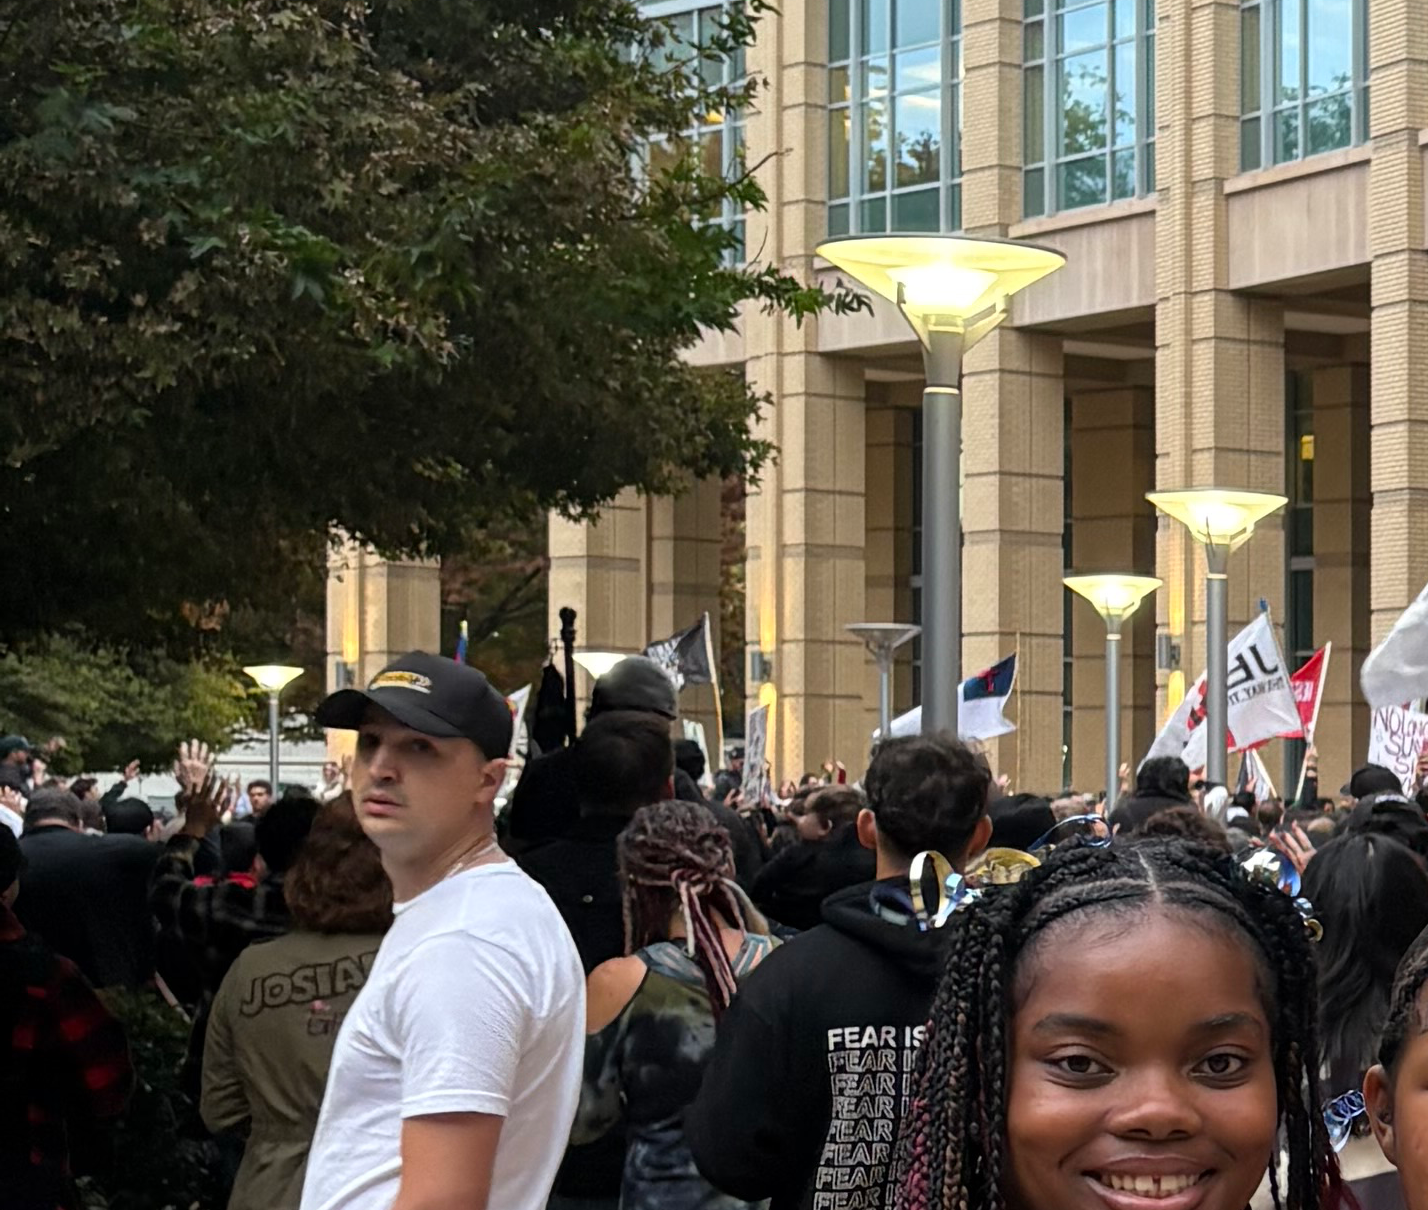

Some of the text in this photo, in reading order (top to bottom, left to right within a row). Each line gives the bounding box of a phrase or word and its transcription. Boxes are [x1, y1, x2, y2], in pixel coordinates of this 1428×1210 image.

[828, 1025, 928, 1051] FEAR IS
[828, 1049, 897, 1073] FEAR
[831, 1073, 896, 1096] FEAR
[832, 1096, 895, 1119] FEAR
[826, 1119, 893, 1142] FEAR
[820, 1143, 890, 1165] FEAR
[816, 1166, 885, 1189] FEAR
